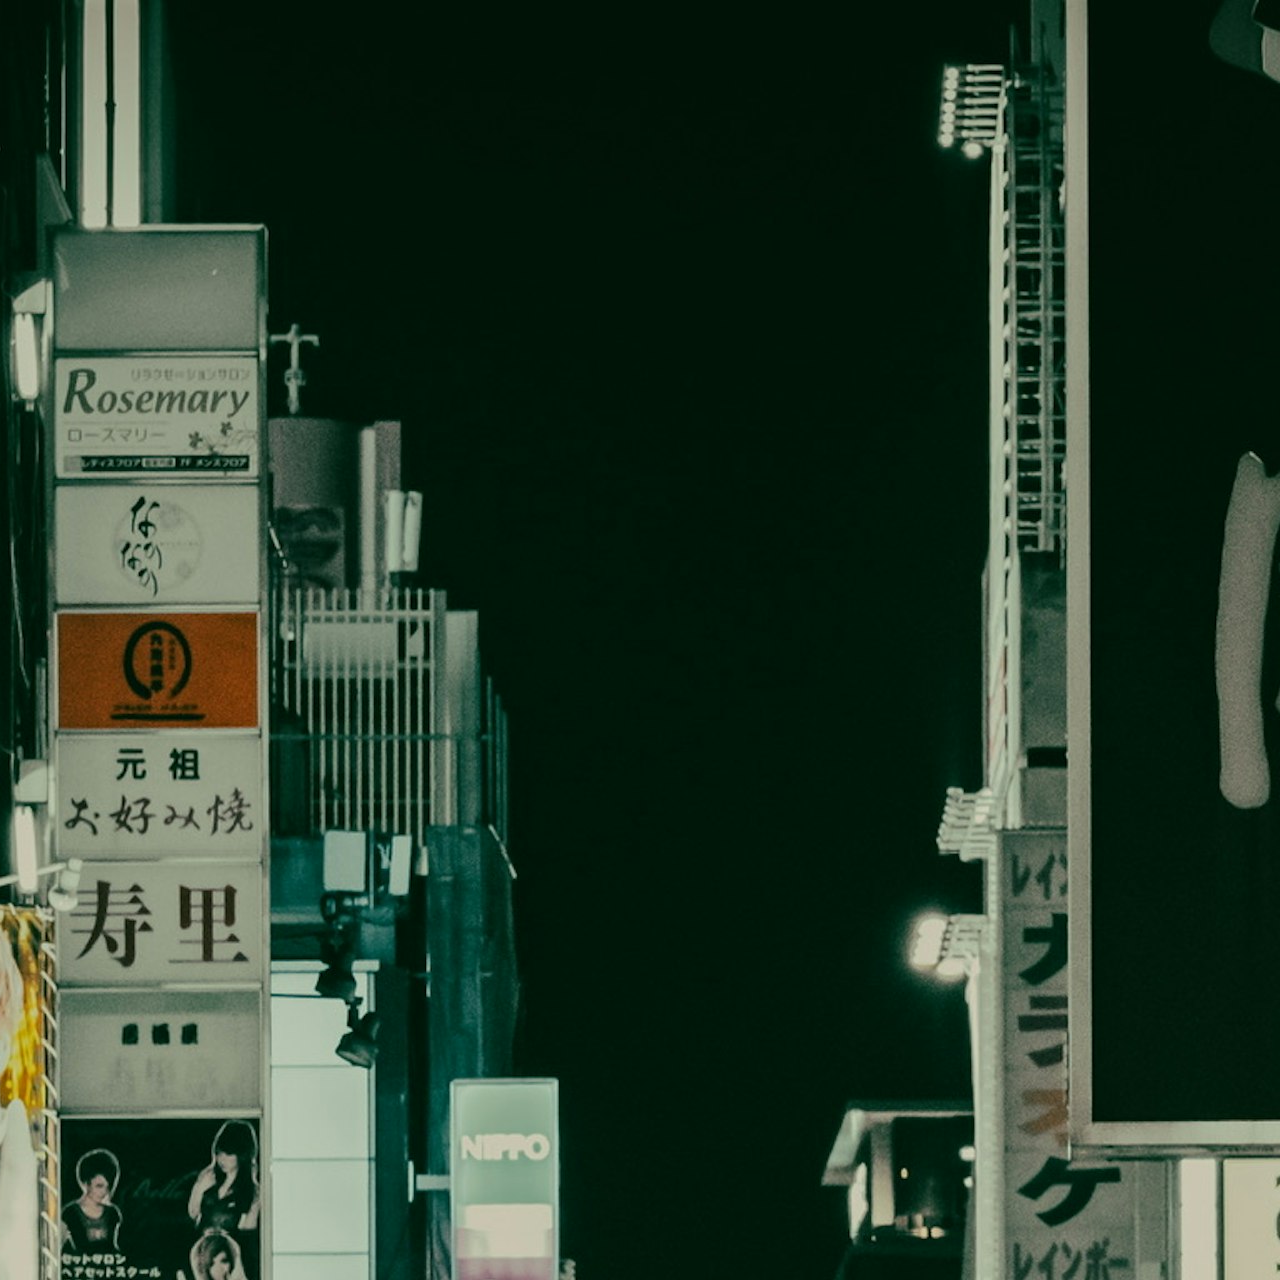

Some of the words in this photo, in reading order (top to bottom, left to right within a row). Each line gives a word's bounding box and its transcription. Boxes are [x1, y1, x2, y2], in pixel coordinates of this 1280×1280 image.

[63, 368, 250, 418] Rosemary
[116, 748, 200, 780] 元祖
[70, 880, 249, 967] 寿里
[461, 1134, 550, 1161] NIPPO
